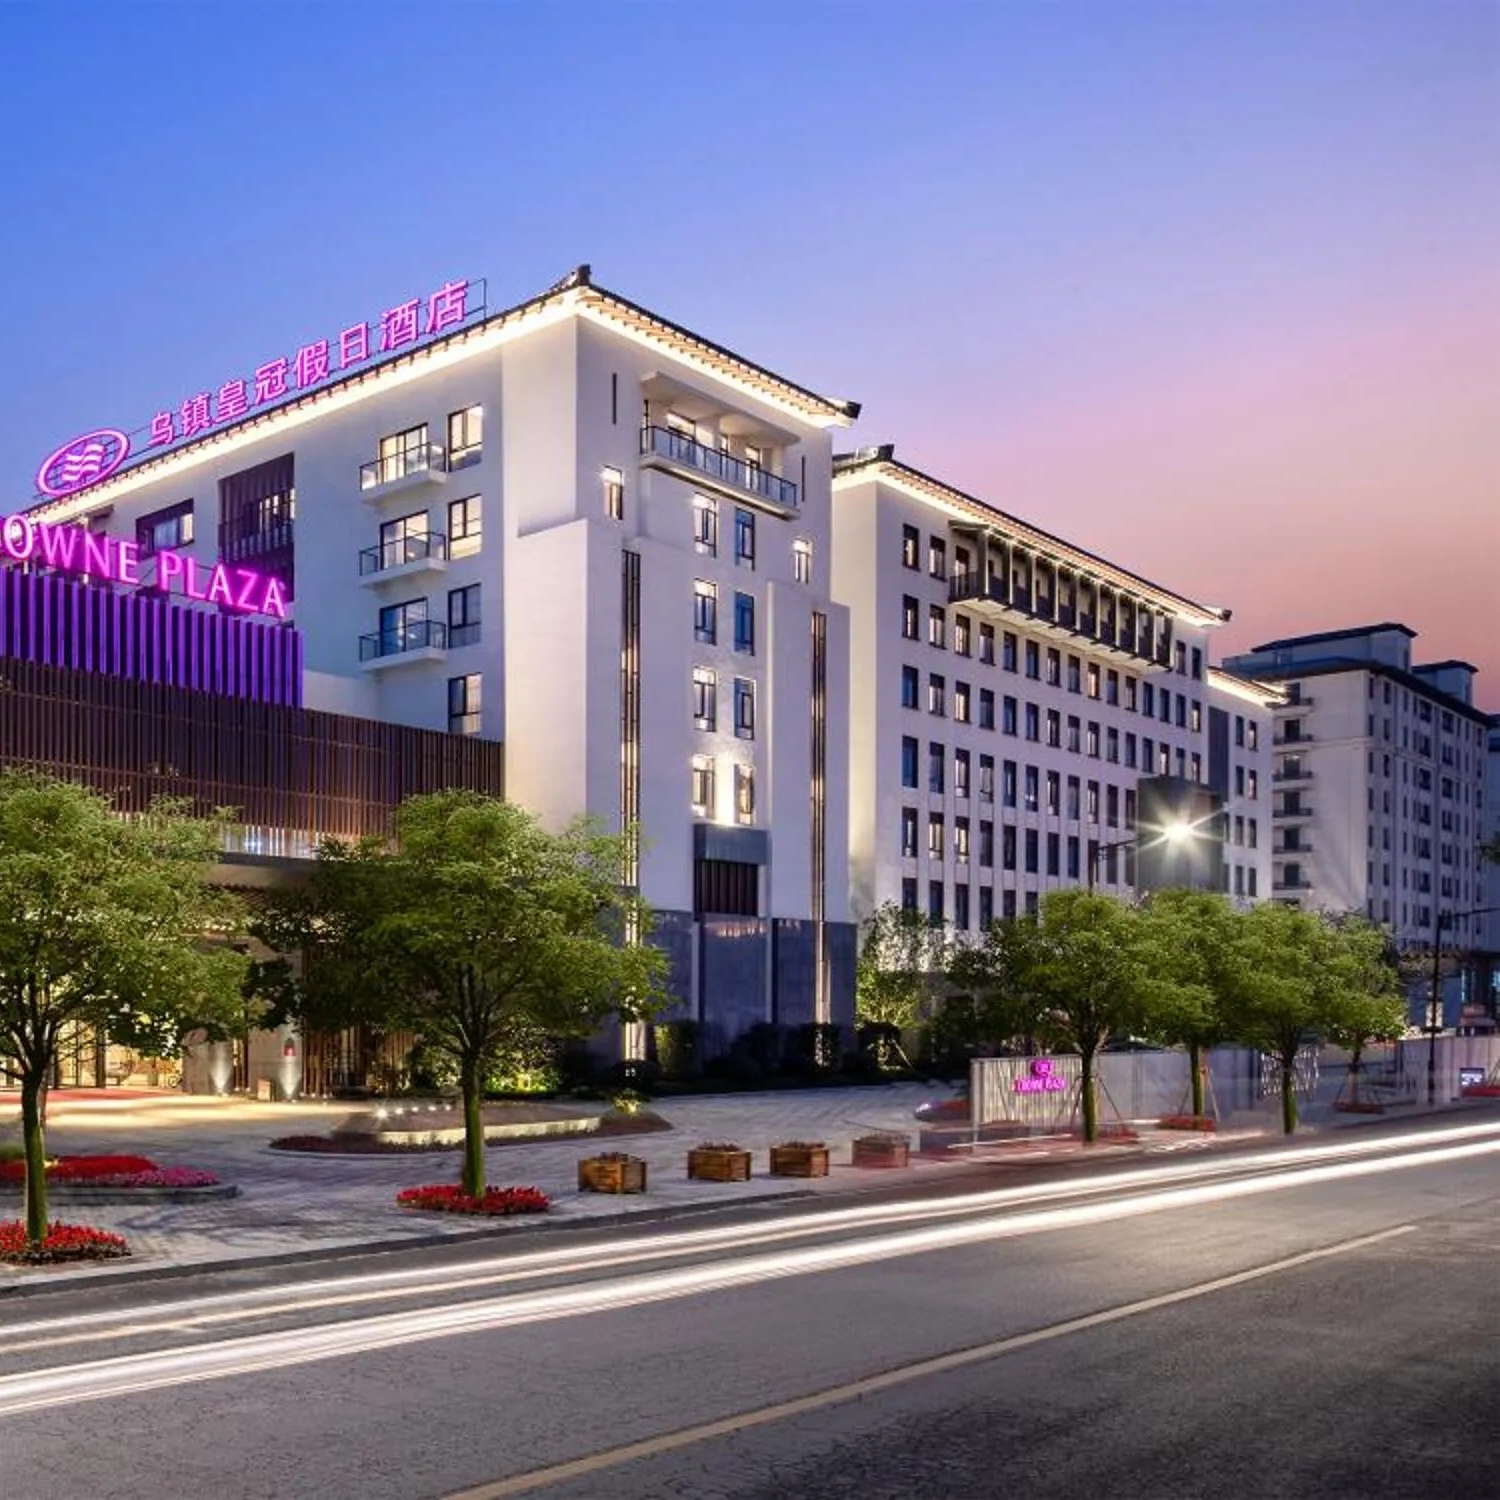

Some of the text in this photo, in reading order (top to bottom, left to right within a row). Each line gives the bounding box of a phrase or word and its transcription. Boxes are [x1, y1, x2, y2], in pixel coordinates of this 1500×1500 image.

[148, 279, 469, 446] 乌镇皇冠假日酒店
[159, 550, 286, 618] PLAZA
